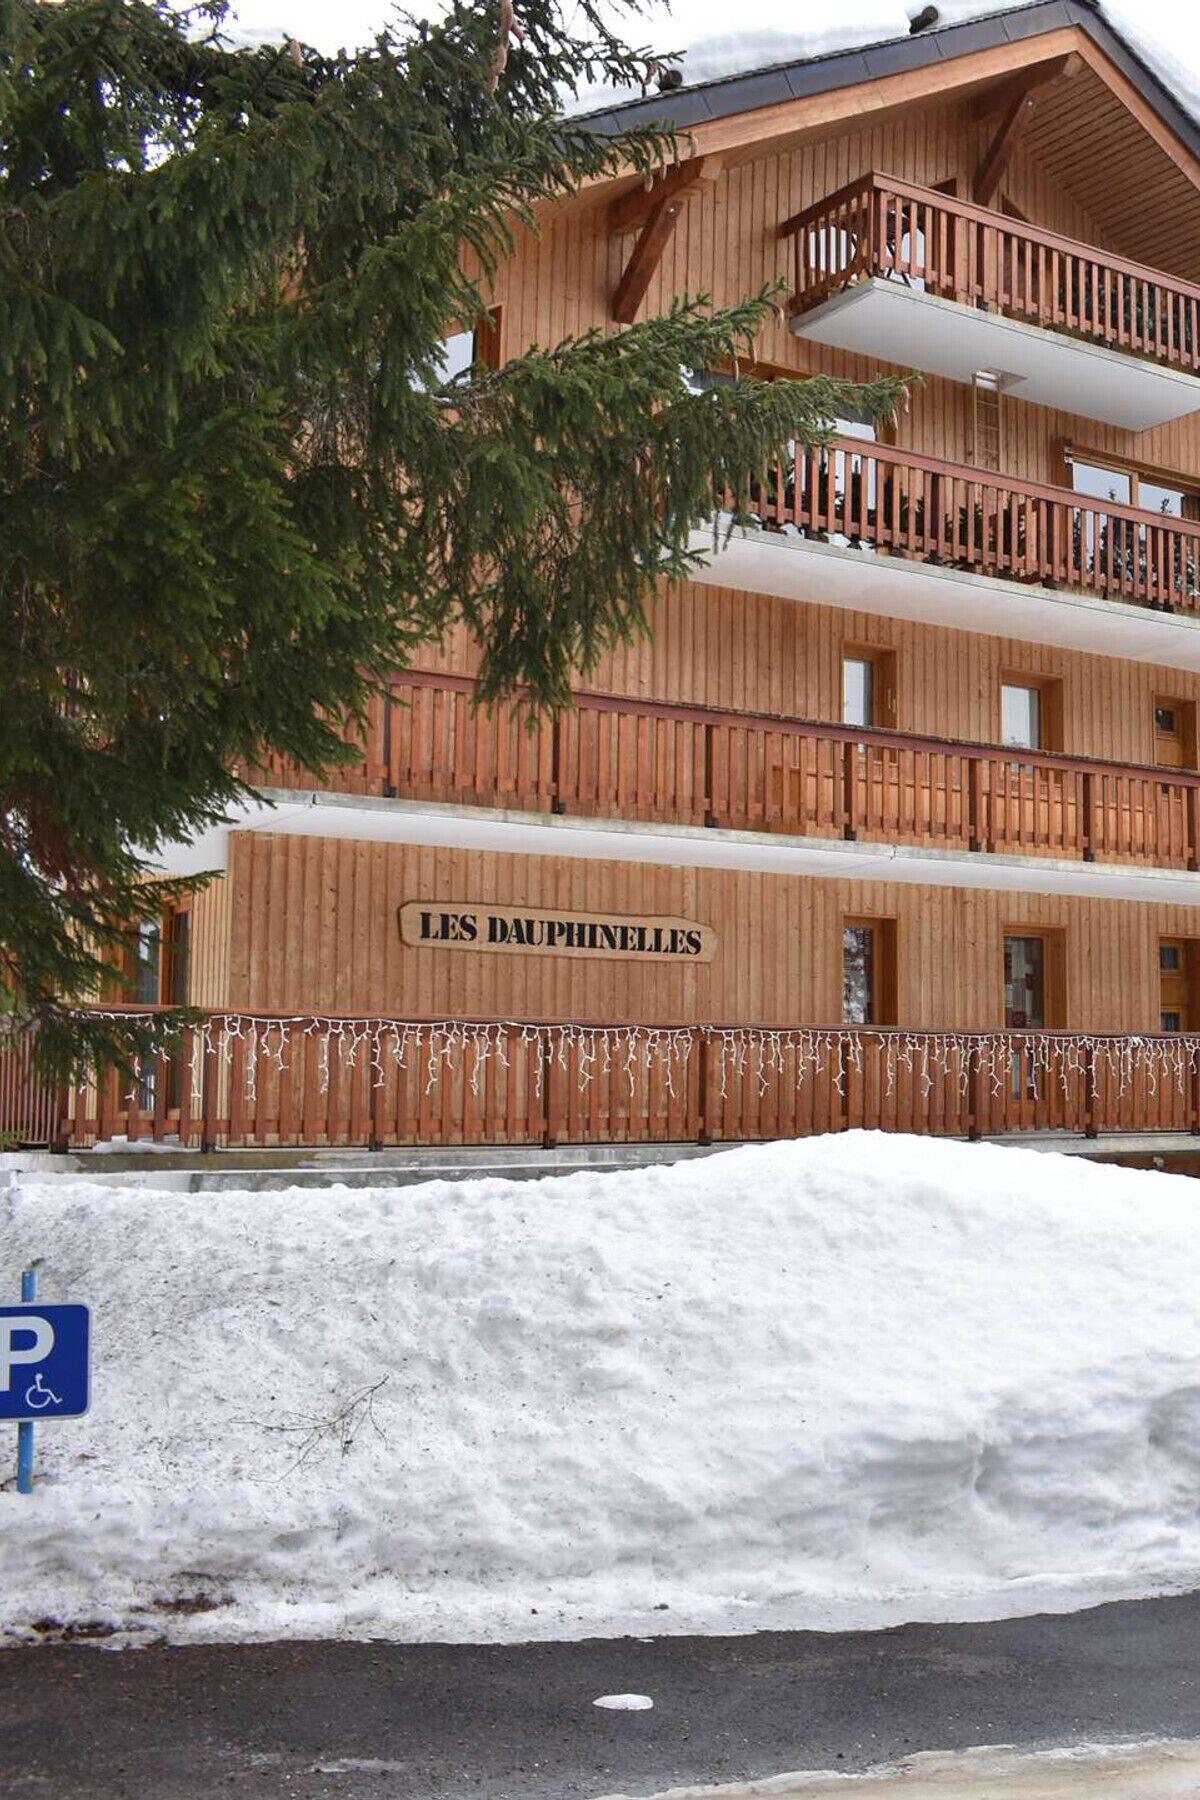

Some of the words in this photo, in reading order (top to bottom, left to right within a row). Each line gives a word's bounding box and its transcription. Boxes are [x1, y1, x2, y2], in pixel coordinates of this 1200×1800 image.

[420, 912, 477, 942] LES
[487, 916, 702, 956] DAUPHINELLES
[0, 1316, 55, 1391] P
